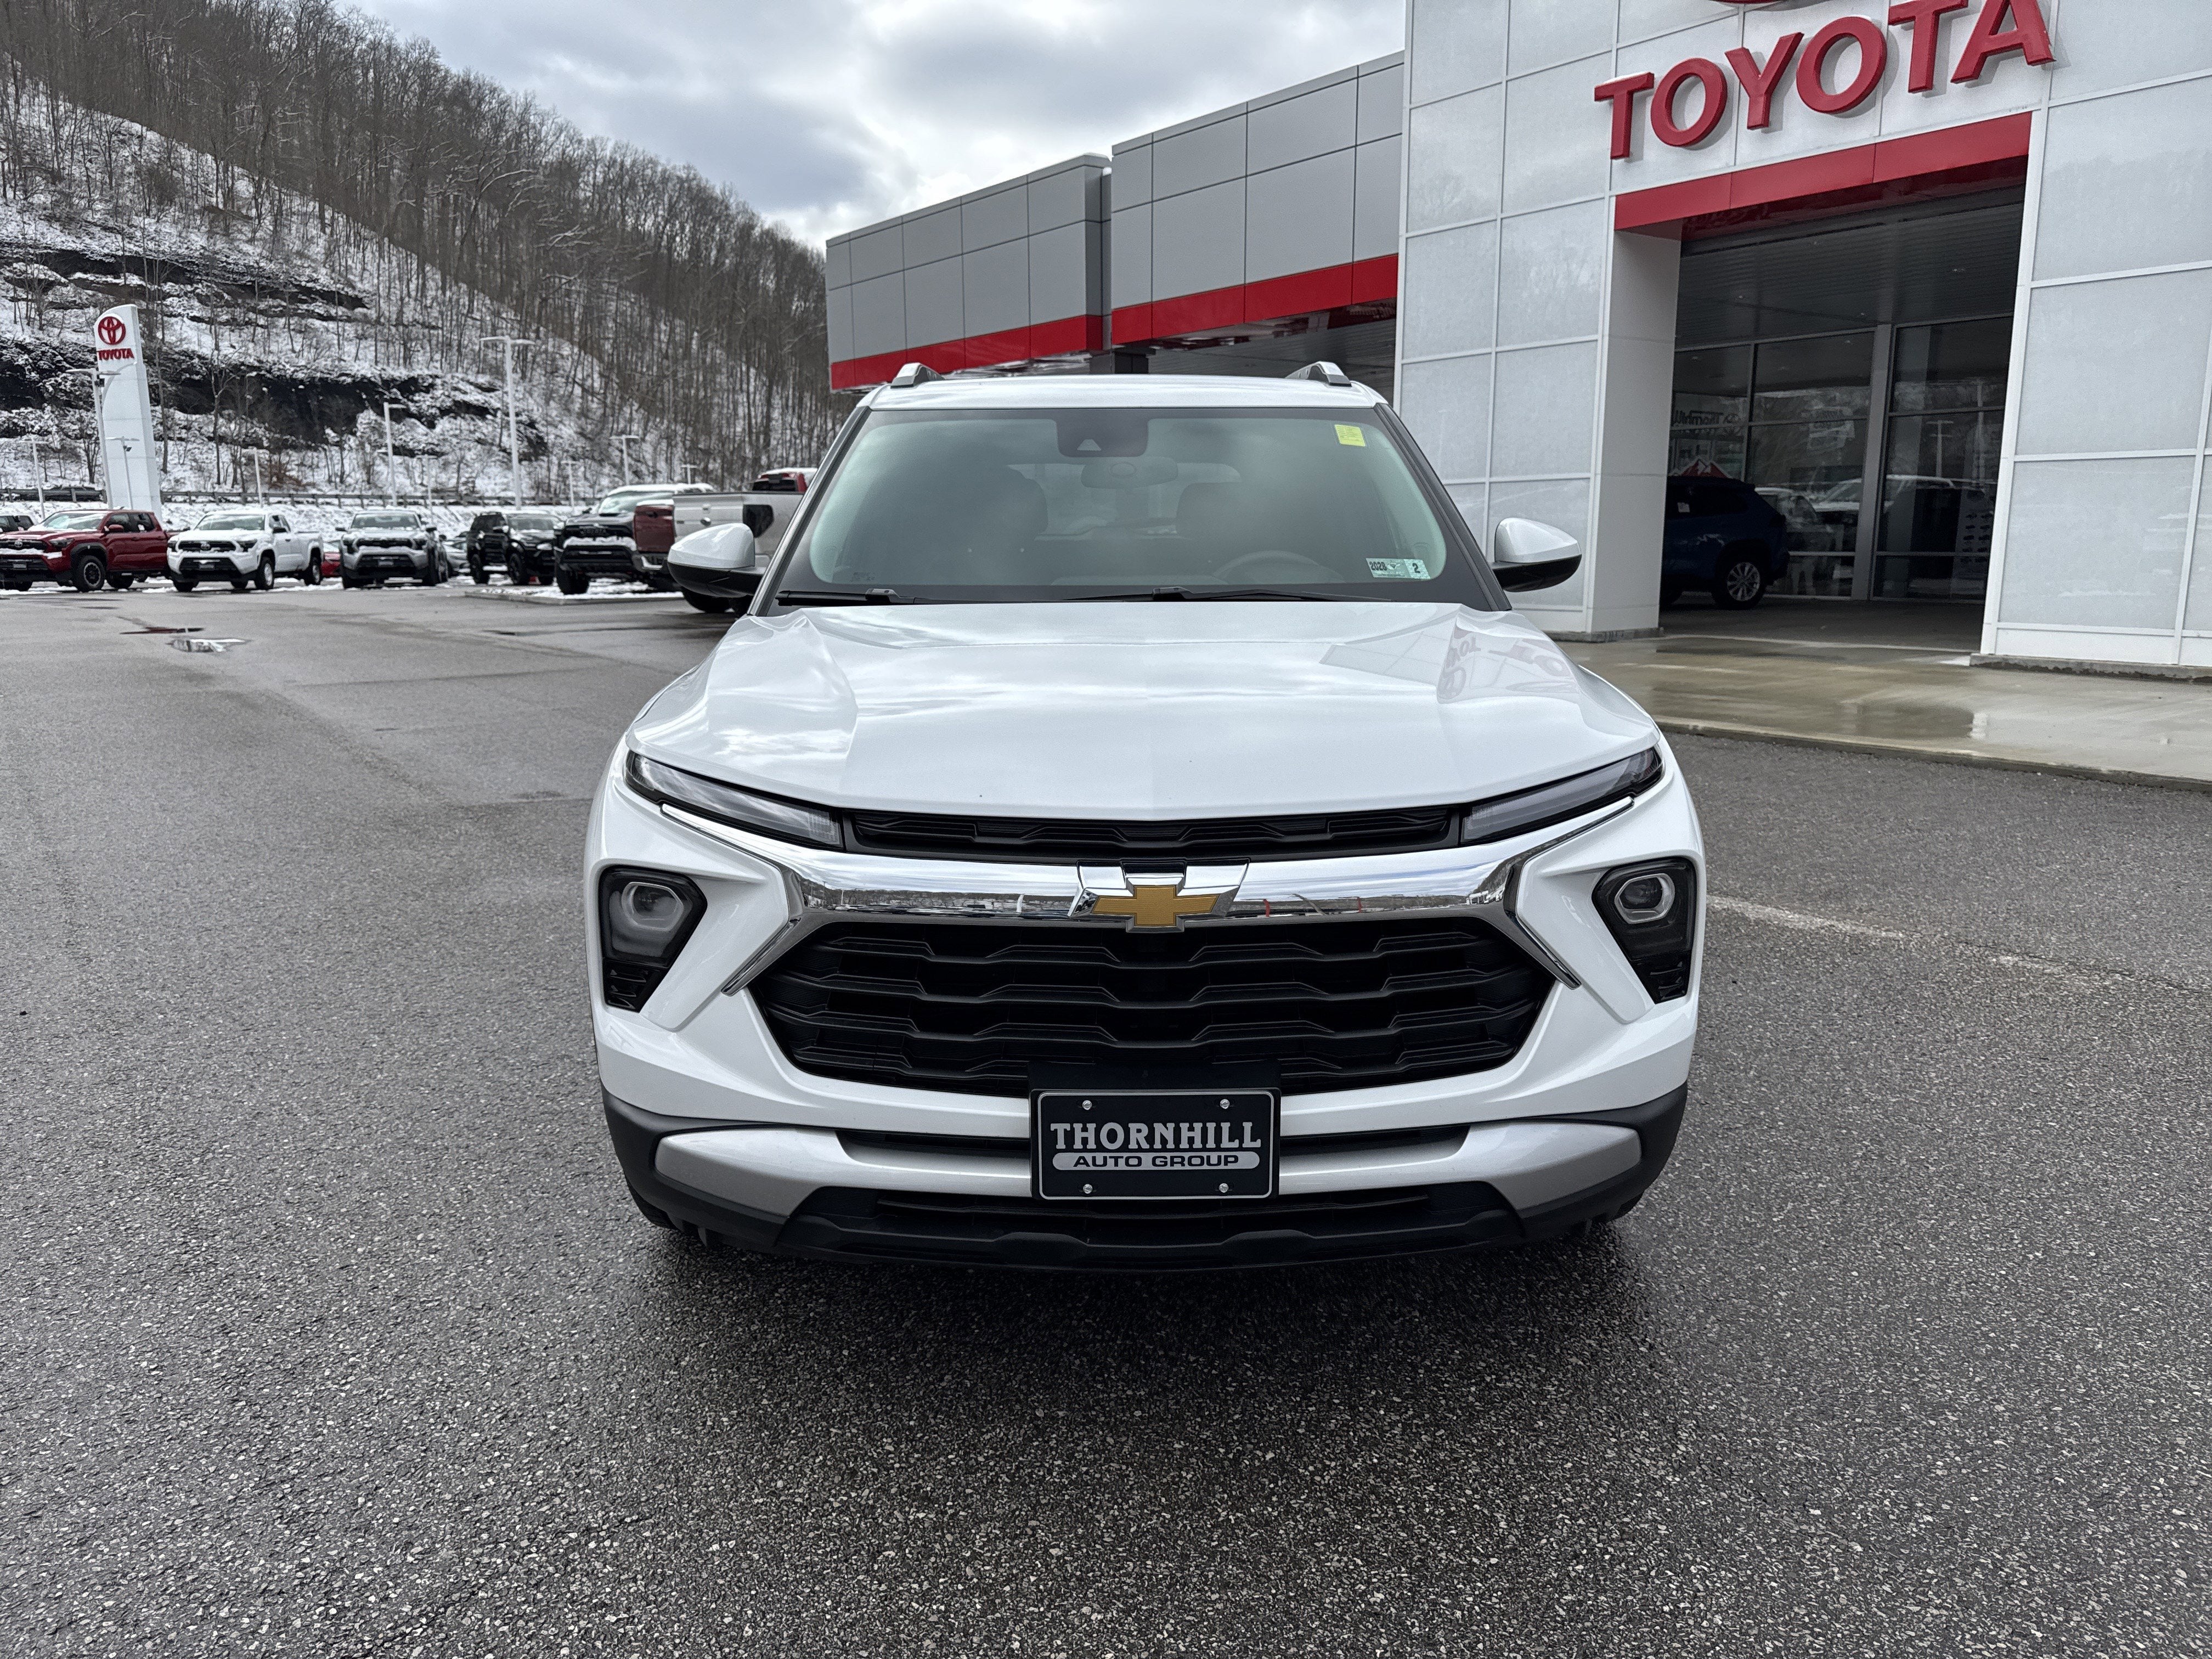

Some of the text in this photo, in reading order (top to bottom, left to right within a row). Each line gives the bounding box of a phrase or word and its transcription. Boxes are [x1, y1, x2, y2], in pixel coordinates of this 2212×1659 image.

[1594, 0, 2056, 160] TOYOTA
[98, 348, 134, 360] TOYOTA
[1369, 562, 1387, 571] 2028
[1412, 563, 1421, 573] 2
[1050, 1122, 1261, 1150] THORNHILL
[1073, 1155, 1239, 1167] AUTO GROUP
